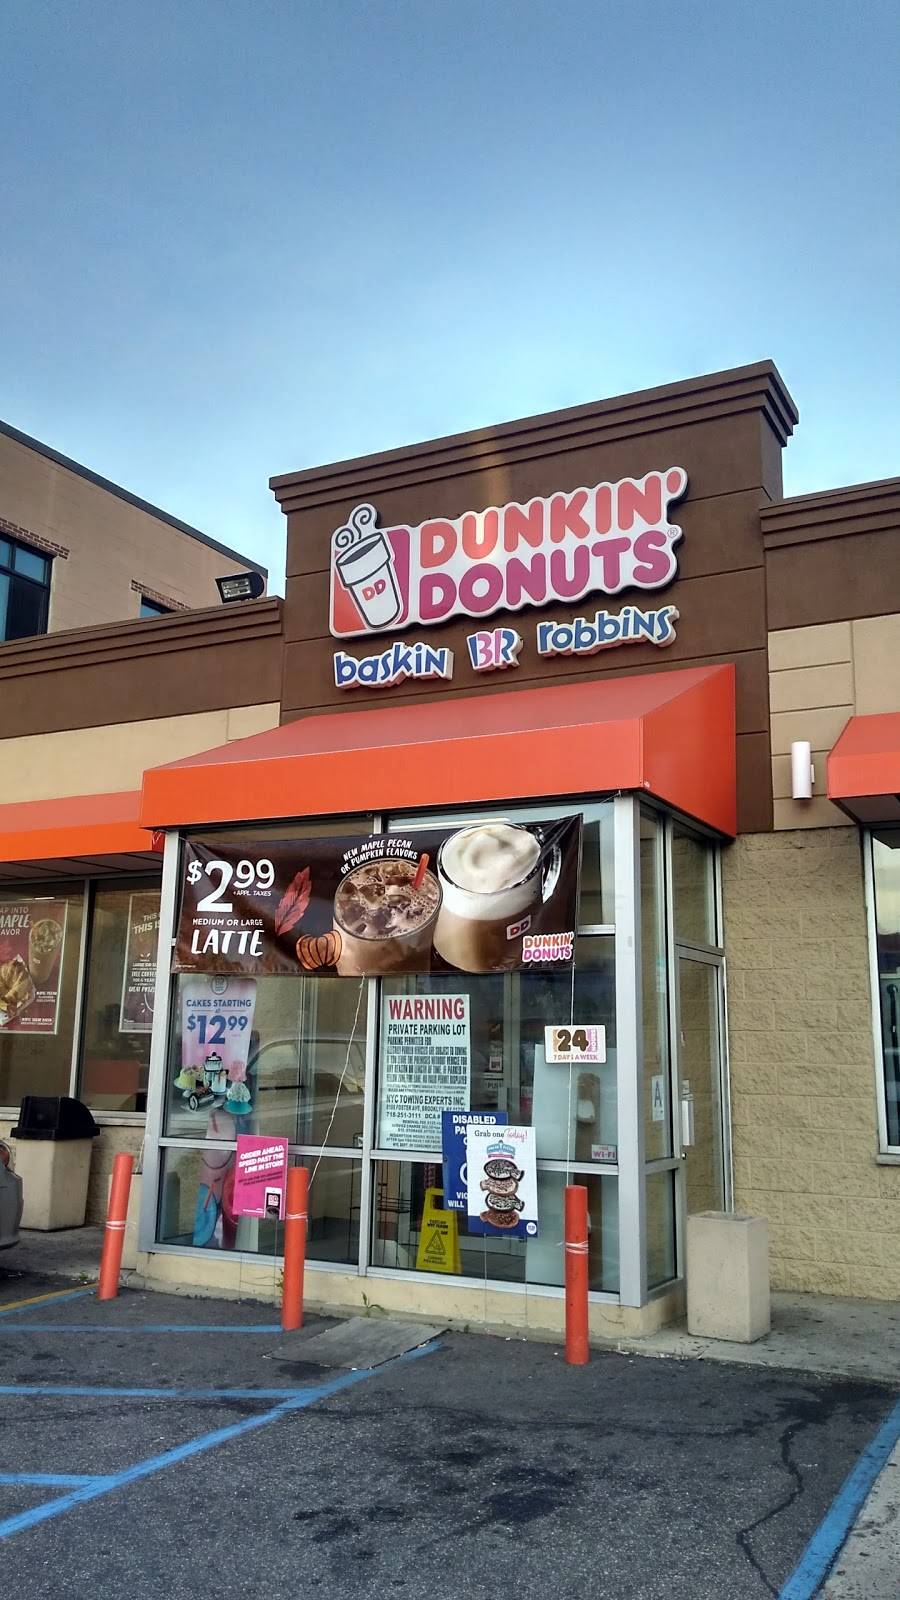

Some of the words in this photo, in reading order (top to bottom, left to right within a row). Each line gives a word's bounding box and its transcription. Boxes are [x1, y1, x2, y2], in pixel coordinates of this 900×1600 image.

[419, 471, 682, 569] DUNKIN'
[419, 530, 671, 621] DONUTS
[362, 578, 386, 601] DD
[343, 848, 358, 861] NEW
[361, 840, 385, 852] MAPLE
[387, 839, 412, 848] PECAN
[340, 863, 351, 874] OR
[351, 848, 384, 866] PUMPKIN
[386, 848, 418, 859] FLAVORS
[0, 928, 21, 936] AVOR
[511, 920, 529, 936] DD
[191, 929, 265, 956] LATTE
[524, 932, 574, 948] DUNKIN'
[524, 945, 571, 960] DONUTS
[213, 1000, 252, 1008] STARTING
[389, 998, 465, 1020] WARNING
[388, 1024, 418, 1035] PRIVATE
[419, 1024, 451, 1035] PARKING
[452, 1024, 466, 1036] LOT
[557, 1029, 589, 1051] 24
[386, 1094, 399, 1103] NYC
[400, 1094, 424, 1105] TOWING
[424, 1095, 453, 1105] EXPERTS
[453, 1096, 466, 1105] INC.
[654, 1080, 662, 1107] A
[452, 1115, 496, 1125] DISABLED
[455, 1126, 467, 1135] PA
[474, 1129, 491, 1137] Grab
[238, 1158, 257, 1168] SPEED
[257, 1155, 272, 1164] PAST
[271, 1152, 284, 1160] THE
[240, 1150, 261, 1160] ORDER
[244, 1165, 258, 1174] LINE
[258, 1163, 267, 1171] IN
[267, 1160, 284, 1169] STORE
[448, 1199, 464, 1208] WILL
